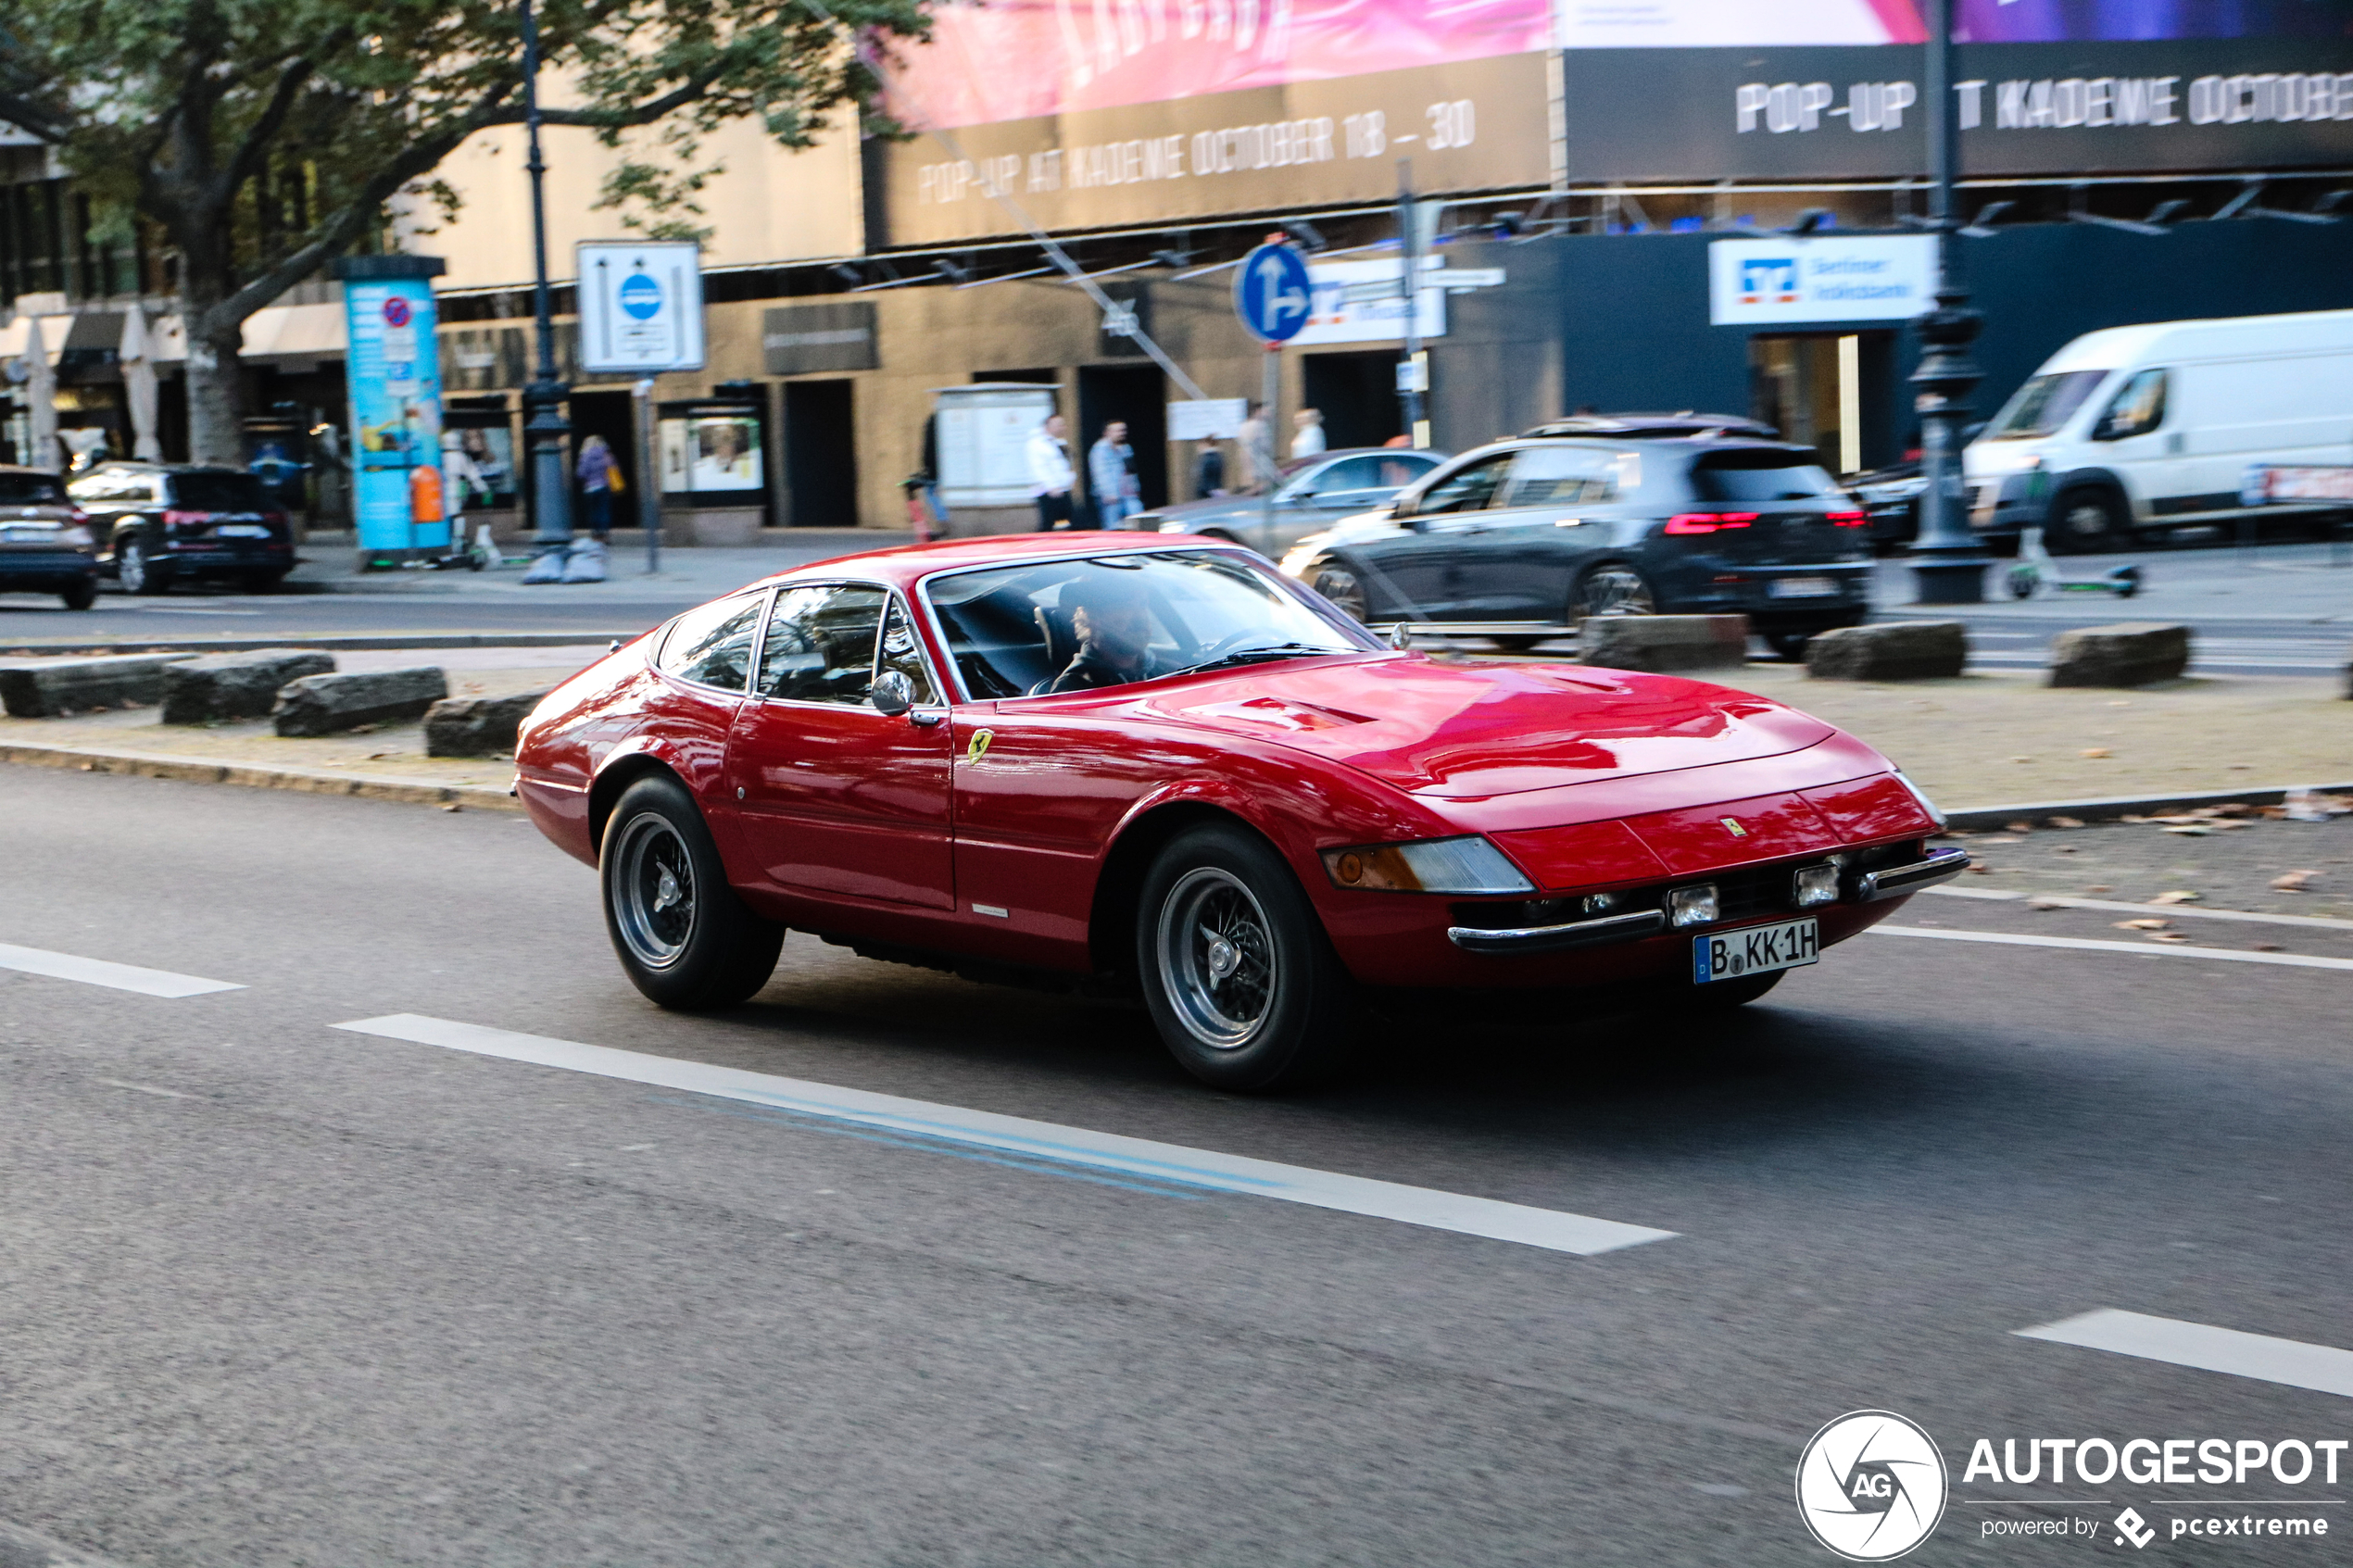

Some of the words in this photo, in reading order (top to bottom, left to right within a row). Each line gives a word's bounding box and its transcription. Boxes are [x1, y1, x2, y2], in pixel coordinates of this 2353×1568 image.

[1736, 81, 1917, 133] POP-UP
[1952, 80, 1989, 131] T
[1995, 76, 2181, 130] KADEWE
[918, 154, 1021, 205] POP-UP
[1026, 149, 1063, 194] AT
[1068, 133, 1187, 189] KADEWE
[1191, 117, 1335, 176] OCTOBER
[1342, 109, 1387, 159] 18
[1425, 98, 1476, 151] 30
